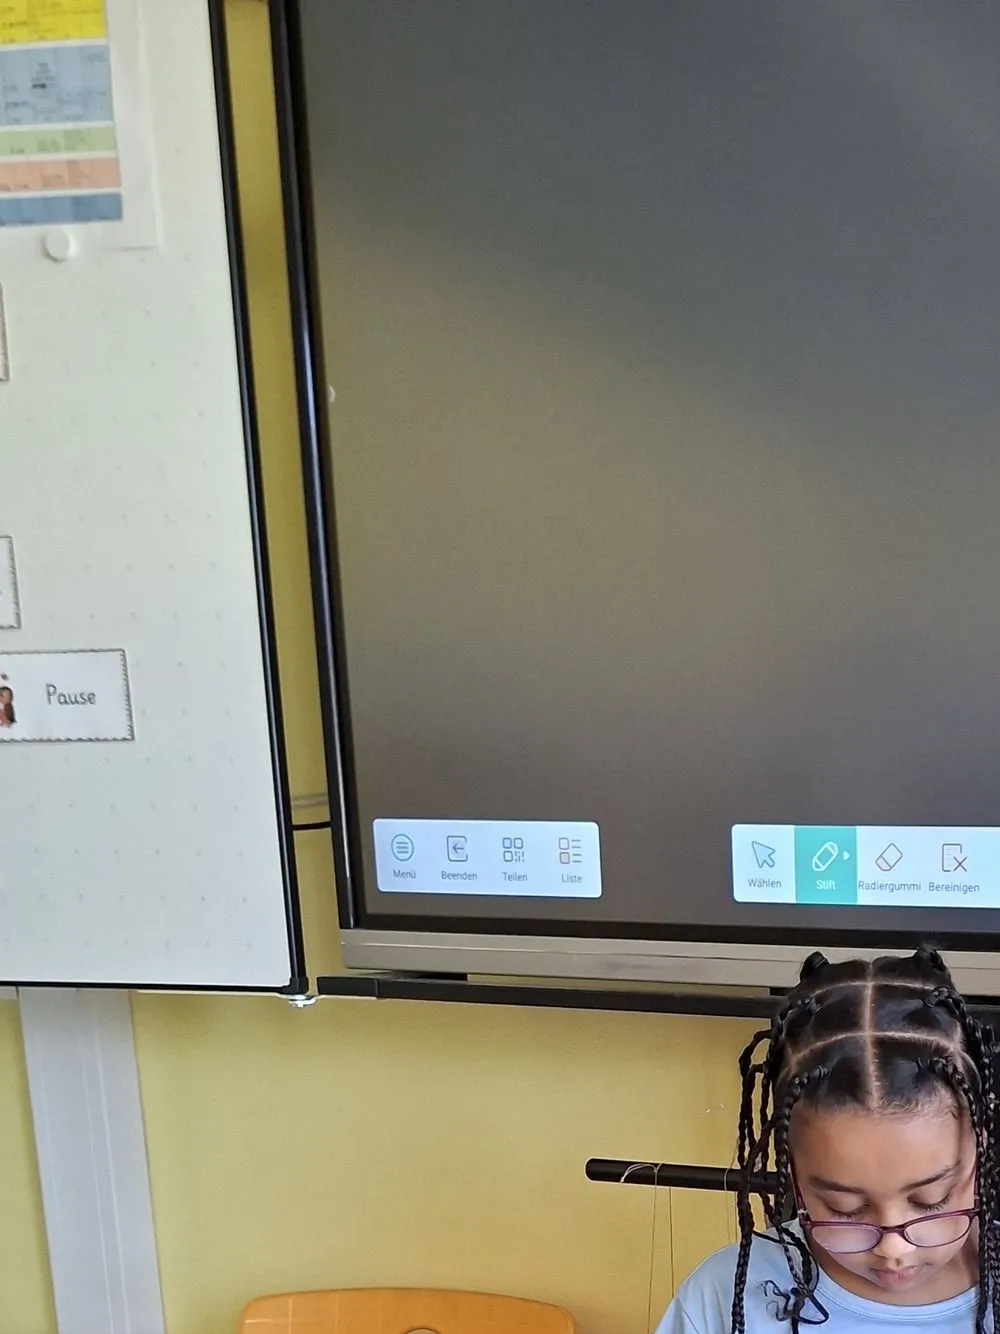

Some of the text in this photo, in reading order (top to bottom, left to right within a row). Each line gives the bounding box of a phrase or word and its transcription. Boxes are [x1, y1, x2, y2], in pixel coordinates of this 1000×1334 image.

[46, 683, 96, 705] Pause
[441, 870, 478, 881] Beenden
[503, 872, 528, 882] Teilen
[561, 874, 583, 883] Liste
[748, 878, 782, 888] Wählen
[816, 879, 837, 890] Stift
[858, 880, 922, 893] Radiergummi
[928, 882, 980, 894] Bereinigen
